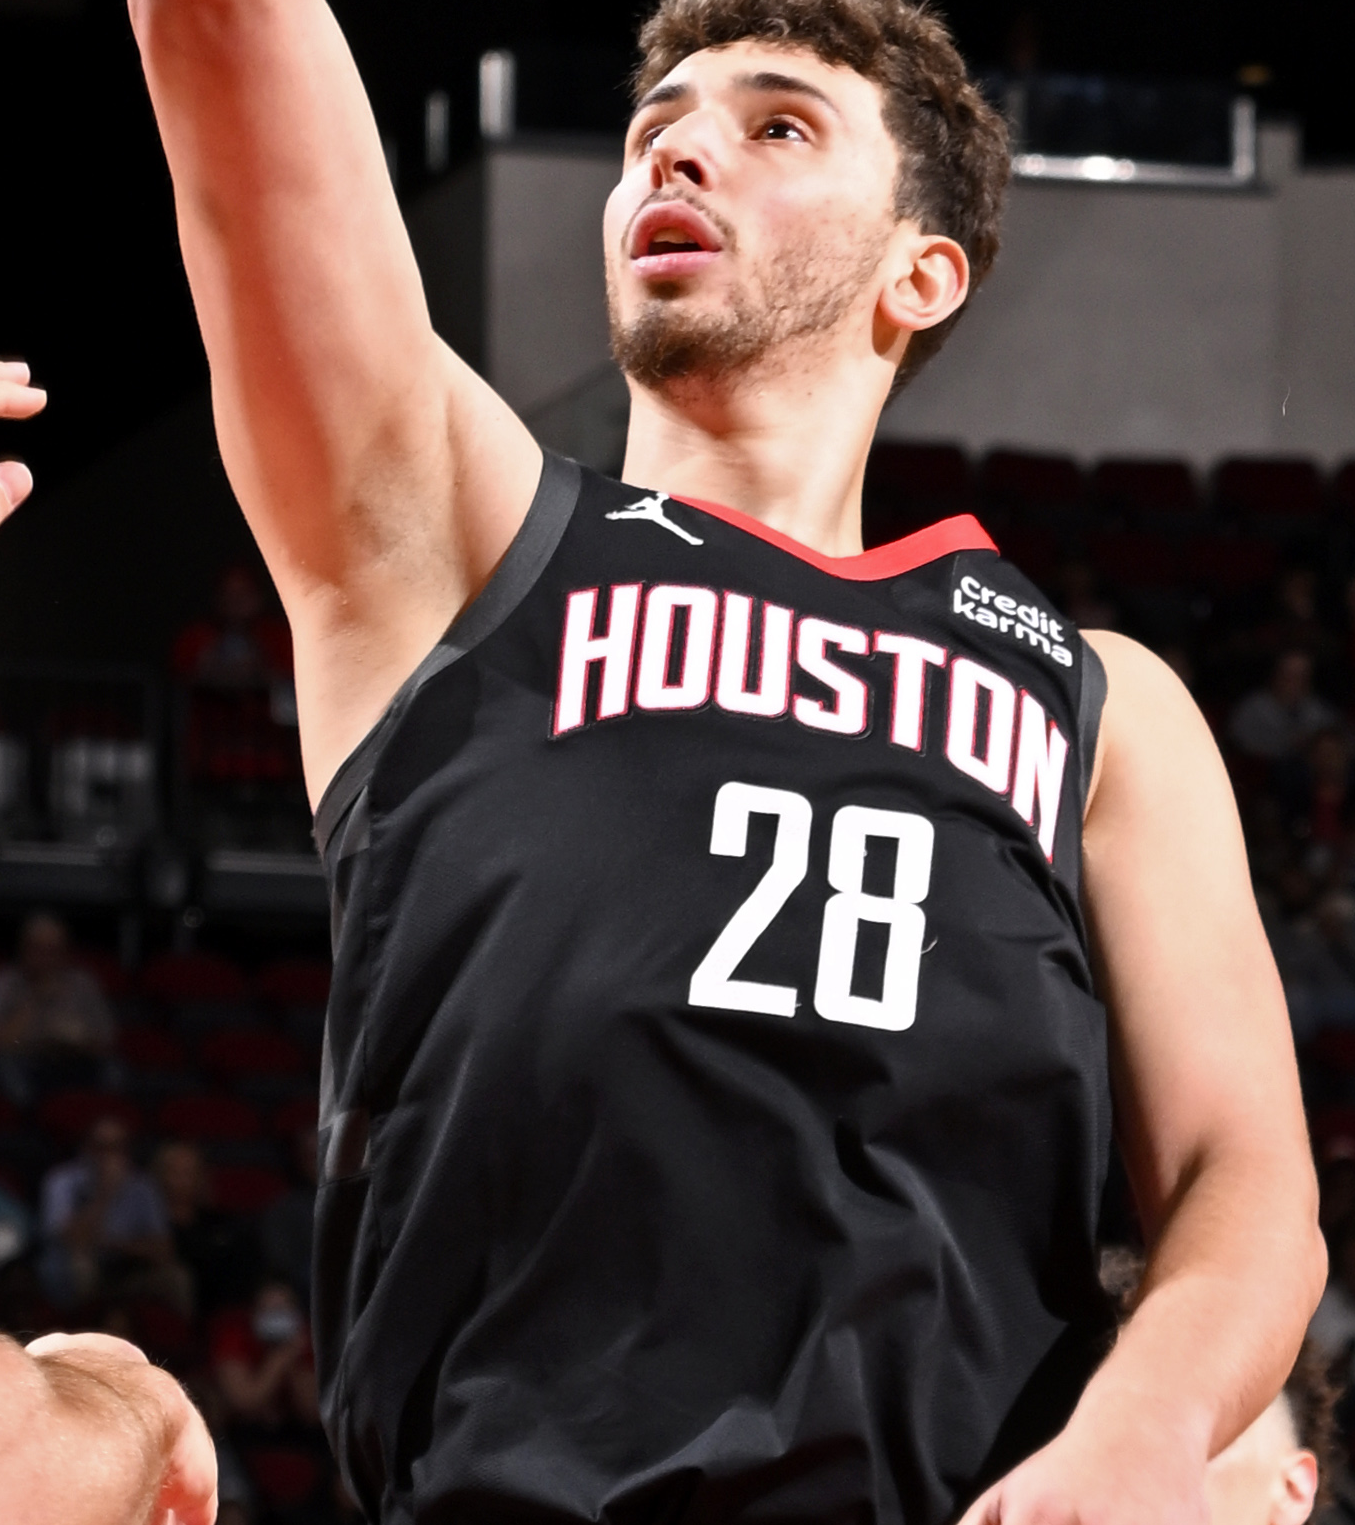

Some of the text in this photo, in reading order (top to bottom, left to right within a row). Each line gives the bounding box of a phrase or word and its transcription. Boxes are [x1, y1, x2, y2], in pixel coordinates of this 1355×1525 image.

[549, 581, 1070, 866] HOUSTON
[953, 588, 1073, 667] karma
[688, 781, 935, 1032] 28
